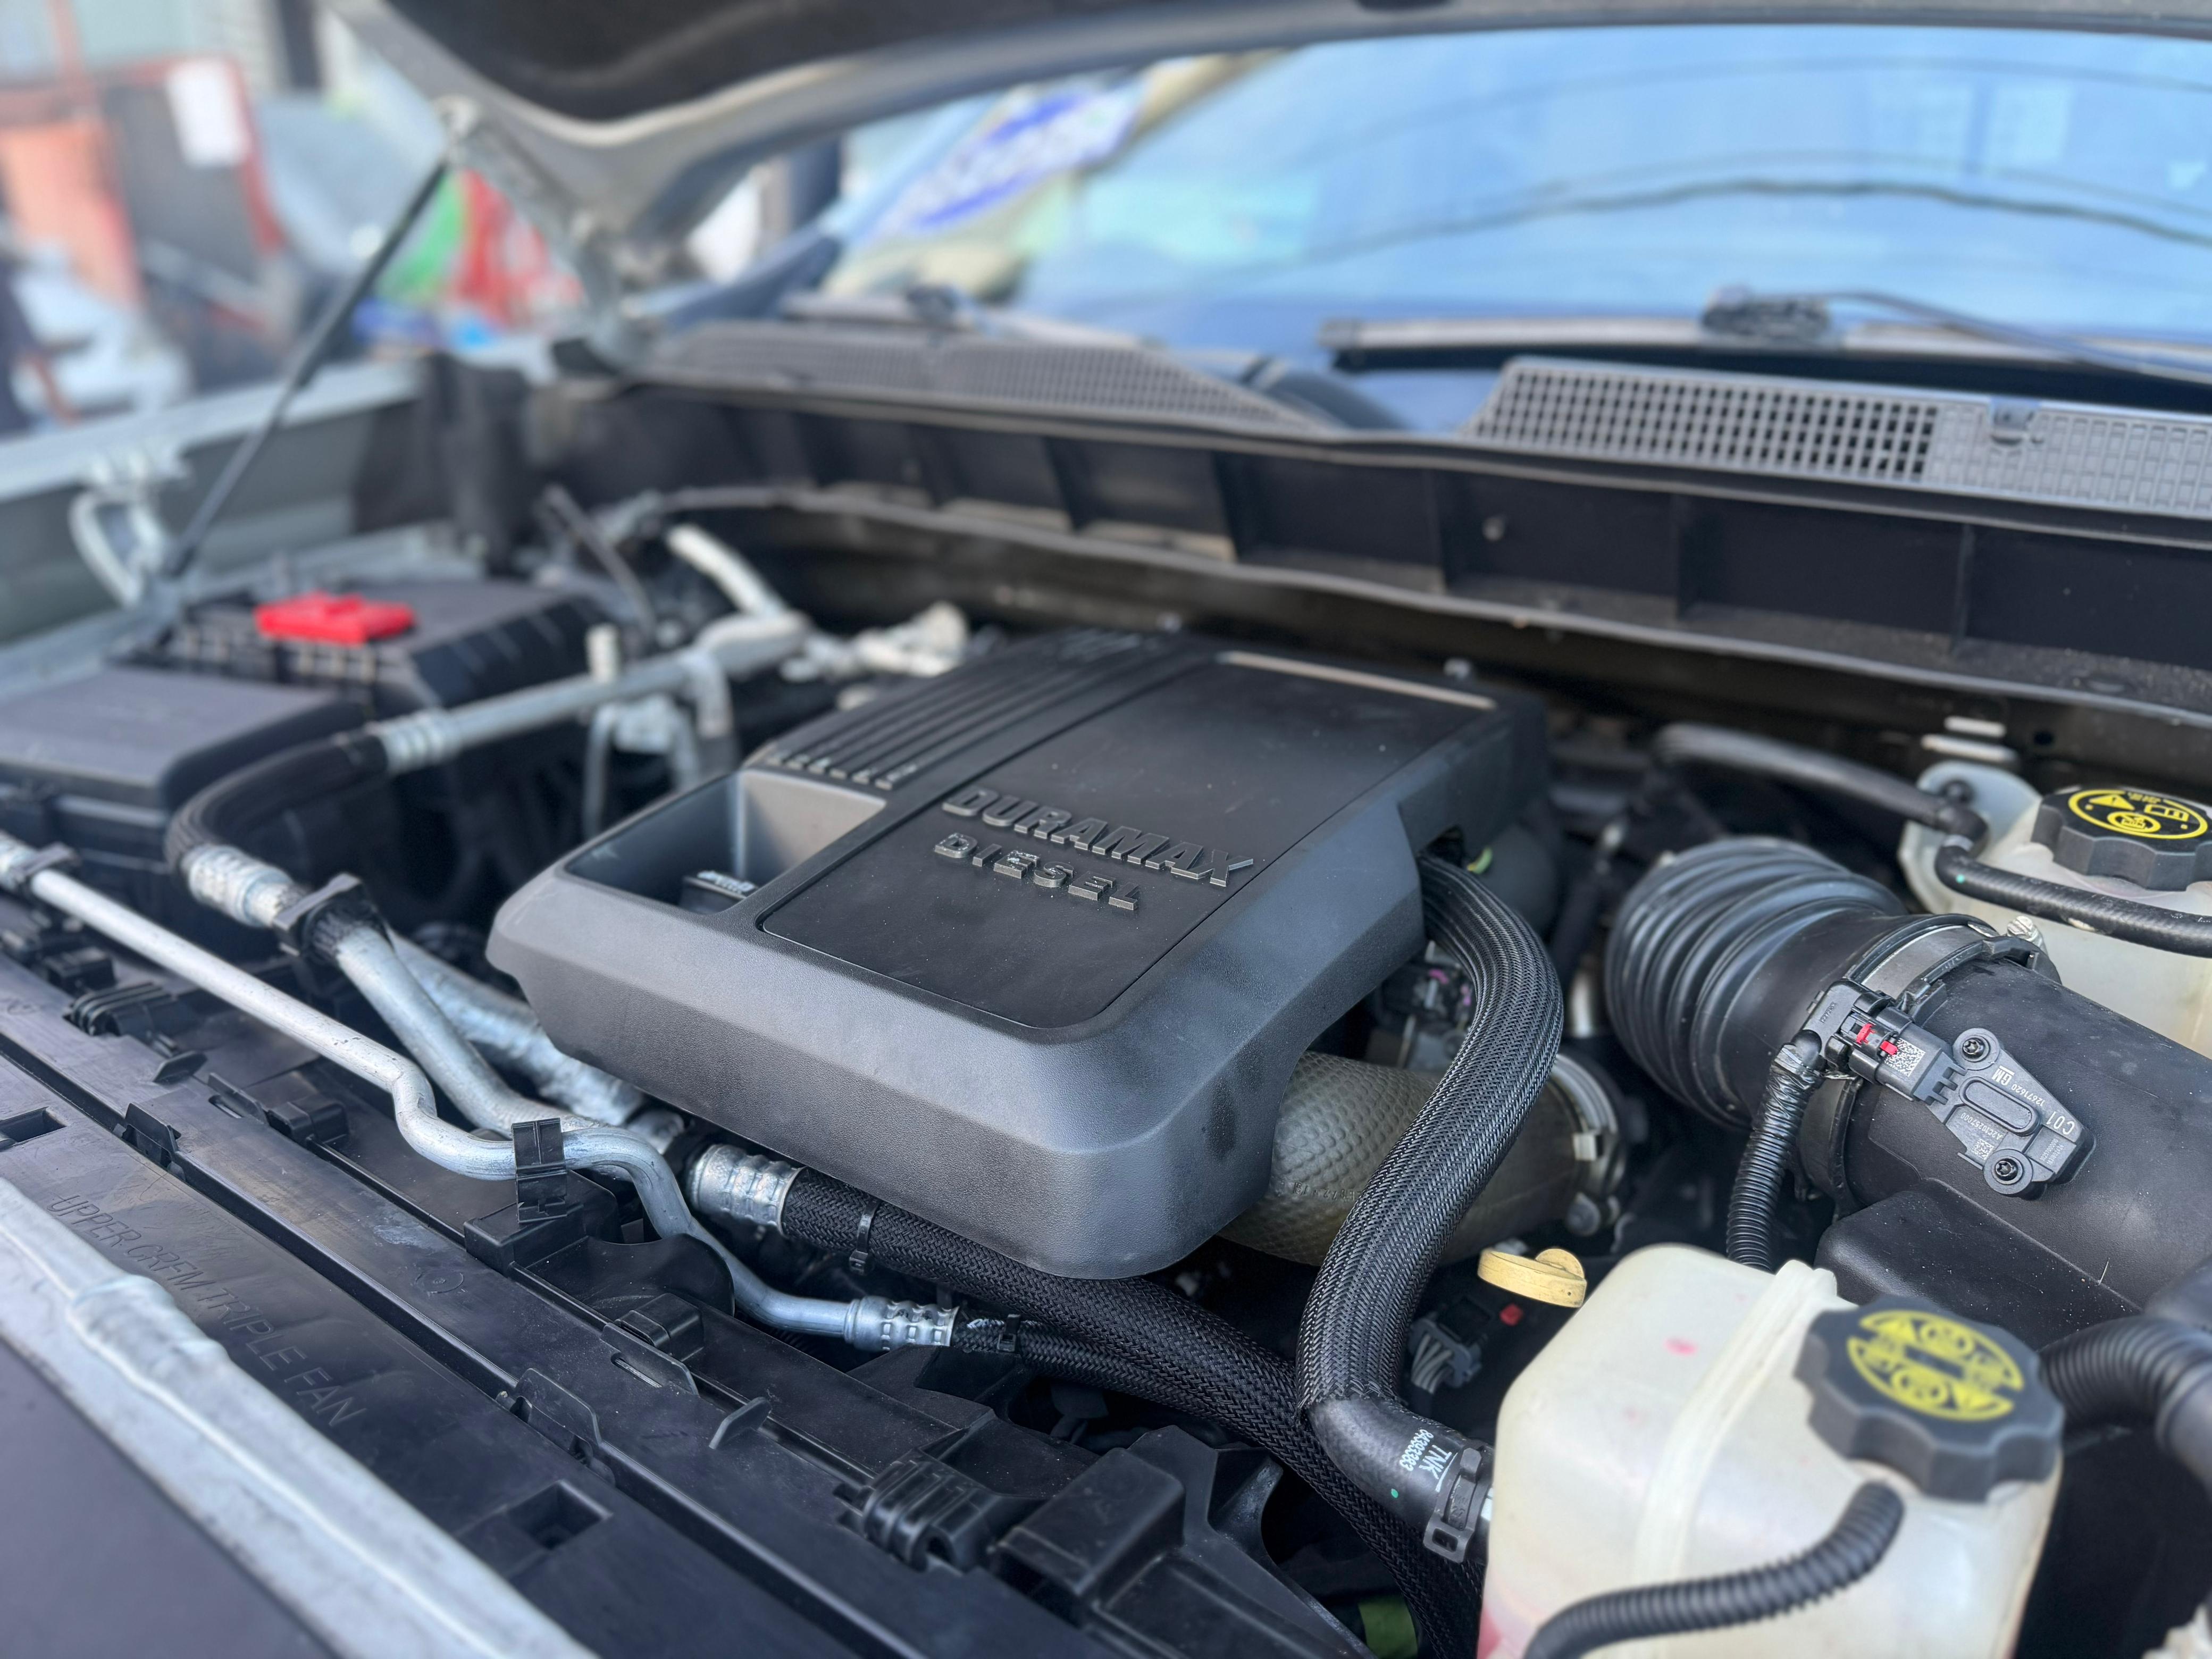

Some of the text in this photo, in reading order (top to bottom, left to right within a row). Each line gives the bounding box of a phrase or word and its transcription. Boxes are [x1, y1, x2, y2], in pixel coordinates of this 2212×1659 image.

[942, 786, 1254, 887] DURAMAX
[934, 833, 1142, 910] DIESEL
[1992, 1065, 2015, 1086] GM
[2011, 1084, 2046, 1107] 12671620
[2046, 1111, 2075, 1135] C01
[47, 1194, 367, 1427] UPPER CRFM TRIPLE FAN
[1419, 1445, 1452, 1479] TNK
